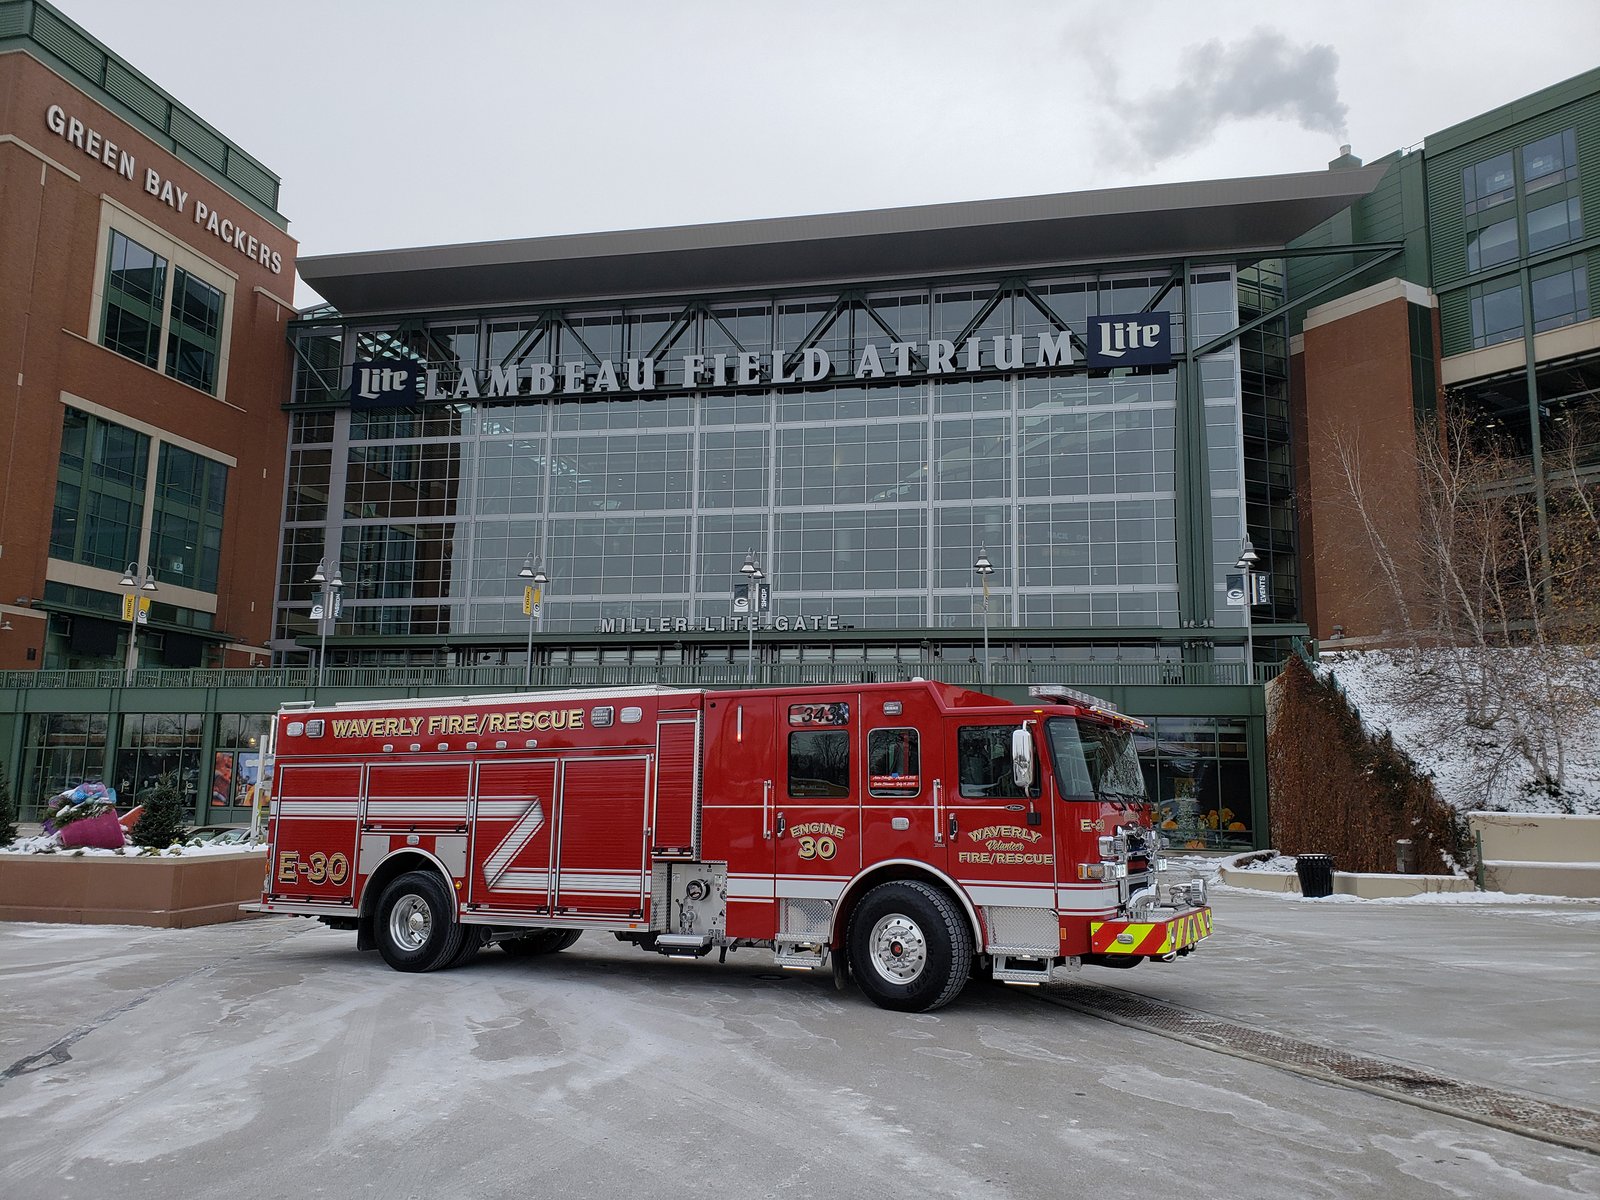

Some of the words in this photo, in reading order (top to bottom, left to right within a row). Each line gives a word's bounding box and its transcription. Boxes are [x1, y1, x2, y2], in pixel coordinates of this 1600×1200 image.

[46, 104, 136, 181] GREEN
[144, 167, 189, 213] BAY
[194, 200, 283, 275] PACKERS
[1097, 322, 1161, 358] Lite
[424, 357, 656, 400] LAMBEAU
[683, 347, 830, 388] FIELD
[854, 330, 1075, 379] ATRIUM
[357, 366, 408, 400] Lite
[1259, 575, 1267, 603] EVENTS
[600, 616, 689, 634] MILLER
[703, 615, 760, 633] LITE
[774, 614, 840, 632] GATE
[331, 714, 423, 738] WAVERLY
[427, 708, 585, 736] FIRE/RESCUE
[801, 706, 838, 723] 343
[789, 822, 846, 839] ENGINE
[967, 825, 1043, 844] WAVERLY
[797, 835, 838, 861] 30
[957, 851, 1054, 865] FIRE/RESCUE
[278, 850, 350, 887] E-30
